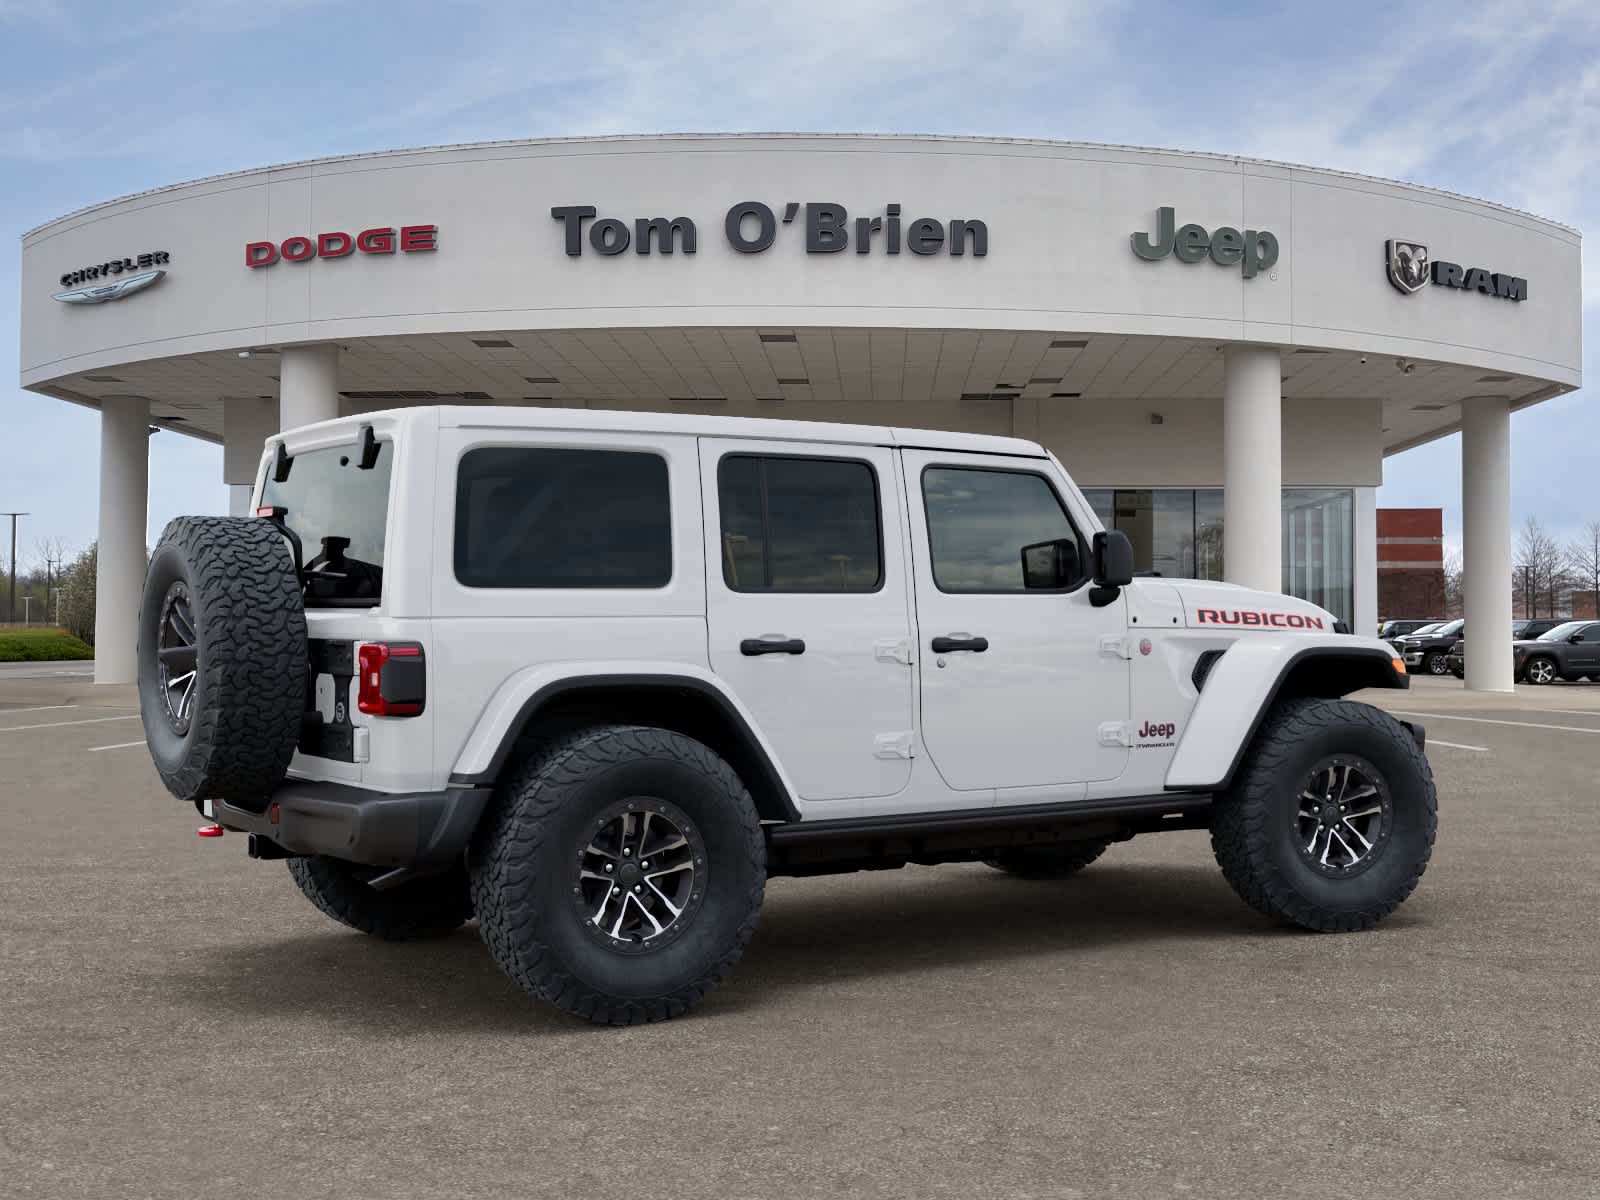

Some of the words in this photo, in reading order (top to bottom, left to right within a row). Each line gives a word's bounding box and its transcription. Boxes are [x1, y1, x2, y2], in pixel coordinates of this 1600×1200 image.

[245, 225, 438, 269] DODGE
[551, 205, 697, 256] Tom
[725, 201, 989, 256] O'Brien
[1130, 206, 1279, 279] Jeep
[60, 250, 170, 286] CHRYSLER
[1431, 260, 1528, 301] RAM
[1197, 608, 1324, 630] RUBICON
[1138, 719, 1176, 739] Jeep
